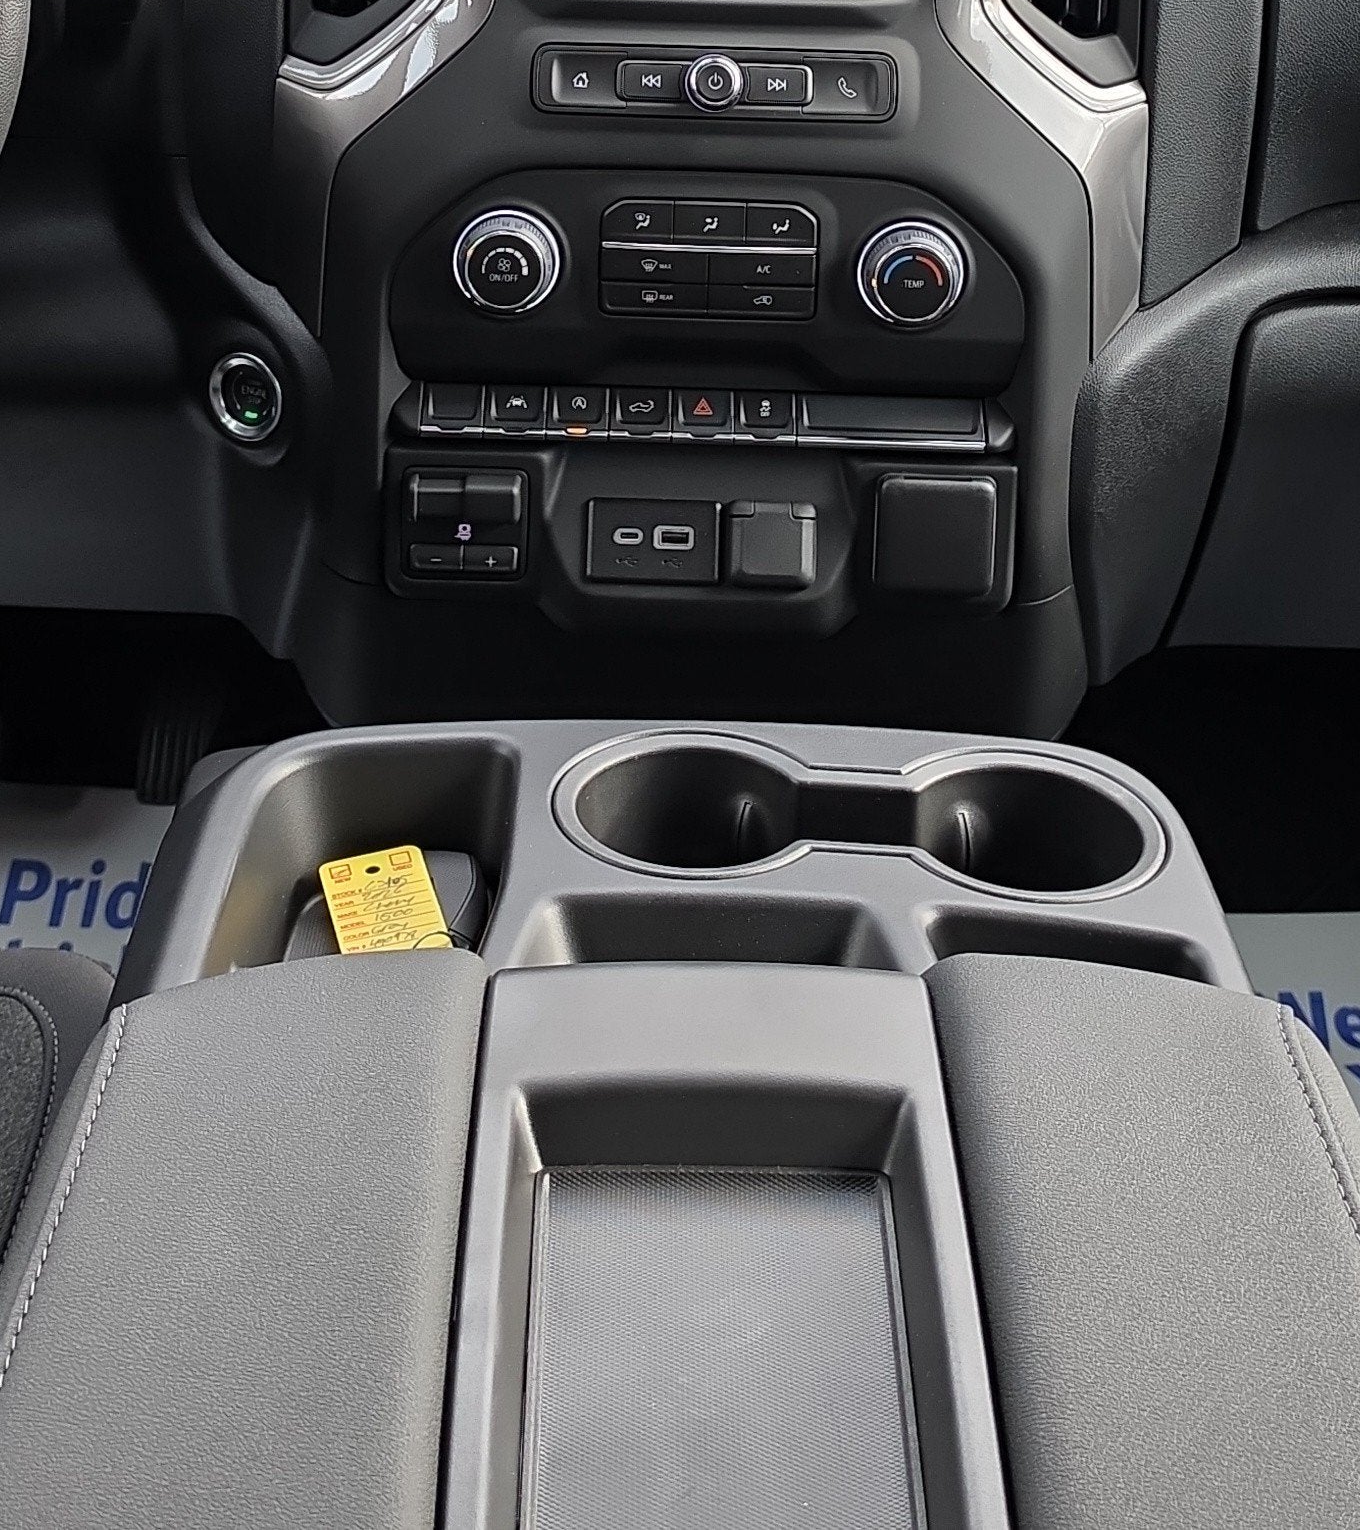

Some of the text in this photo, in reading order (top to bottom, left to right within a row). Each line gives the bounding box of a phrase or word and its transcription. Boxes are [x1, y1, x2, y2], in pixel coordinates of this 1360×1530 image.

[755, 265, 772, 275] A/C
[488, 273, 520, 283] ON/OFF
[902, 279, 925, 289] TEMP
[331, 889, 358, 901] STOCK
[333, 900, 355, 908] YEAR
